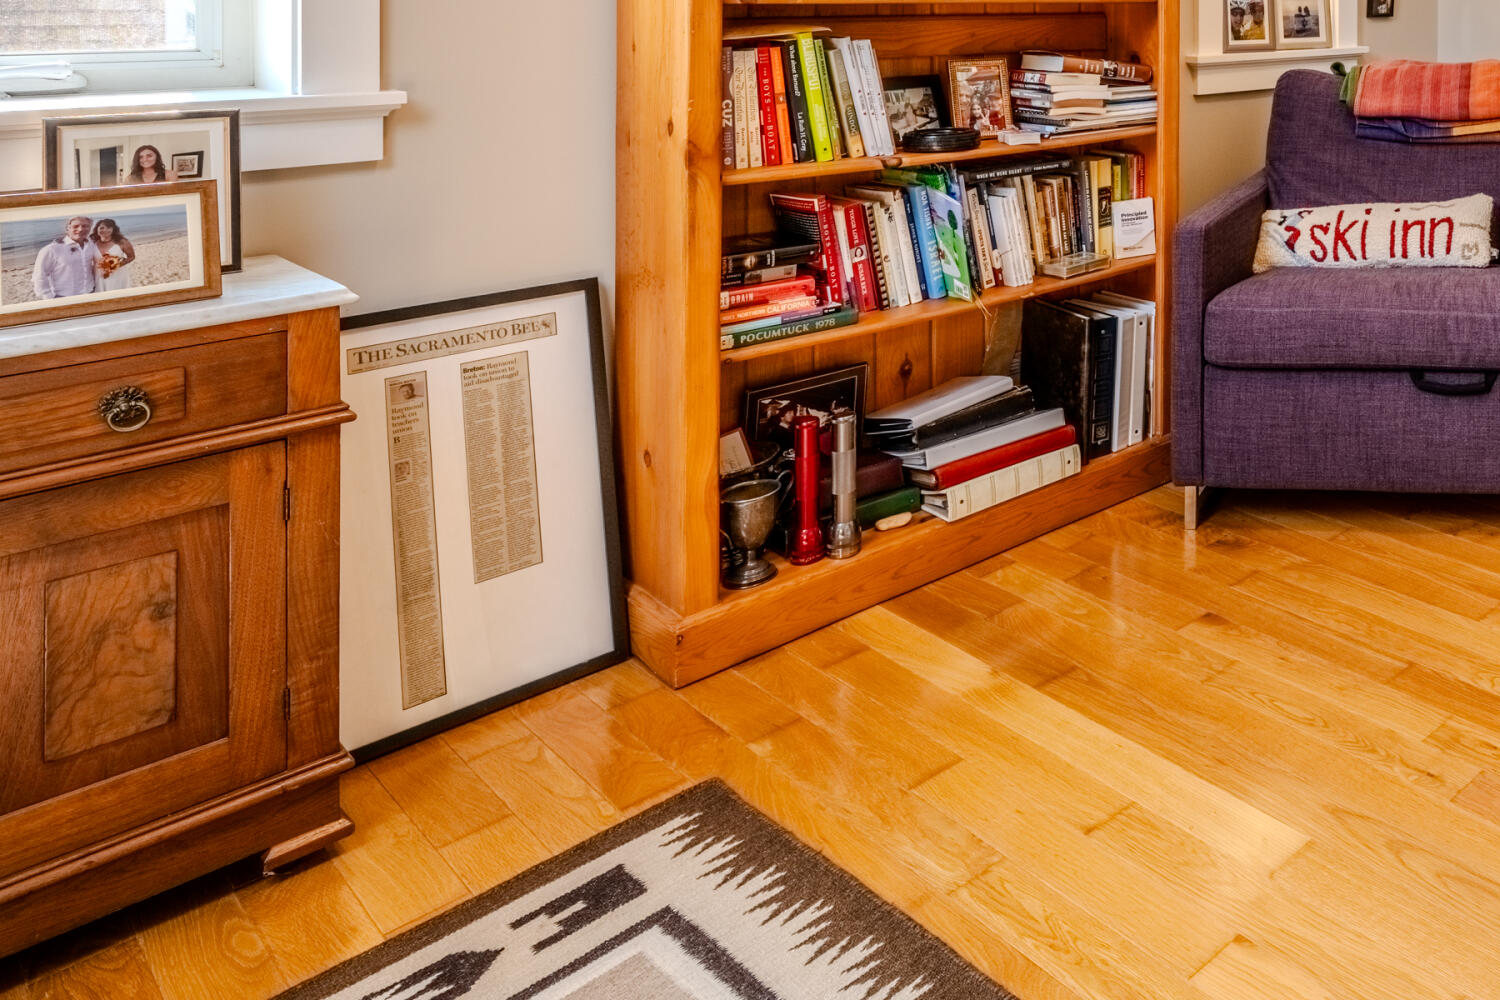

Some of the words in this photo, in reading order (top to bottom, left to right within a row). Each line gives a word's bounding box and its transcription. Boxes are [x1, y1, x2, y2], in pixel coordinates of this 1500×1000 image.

[801, 37, 820, 90] BLINDSPOT
[762, 78, 771, 103] BOYS
[721, 99, 732, 127] CUZ
[766, 124, 775, 150] BOAT
[919, 190, 928, 205] NOA
[848, 208, 856, 228] TOUGH
[922, 206, 933, 229] TISHBY
[851, 229, 859, 244] LOVE
[1310, 209, 1372, 262] ski
[1389, 208, 1454, 259] inn
[822, 223, 831, 247] BOYS
[828, 265, 838, 289] BOAT
[925, 239, 944, 281] ISRAEL
[730, 293, 754, 304] BRAIN
[767, 300, 810, 313] CALIFORNIA
[353, 347, 393, 365] THE
[396, 328, 508, 358] SACRAMENTO
[511, 322, 541, 336] BEE
[740, 323, 809, 344] POCUMTUCK
[815, 318, 836, 329] 1978
[487, 358, 516, 369] Raymond
[392, 402, 424, 414] Raymond
